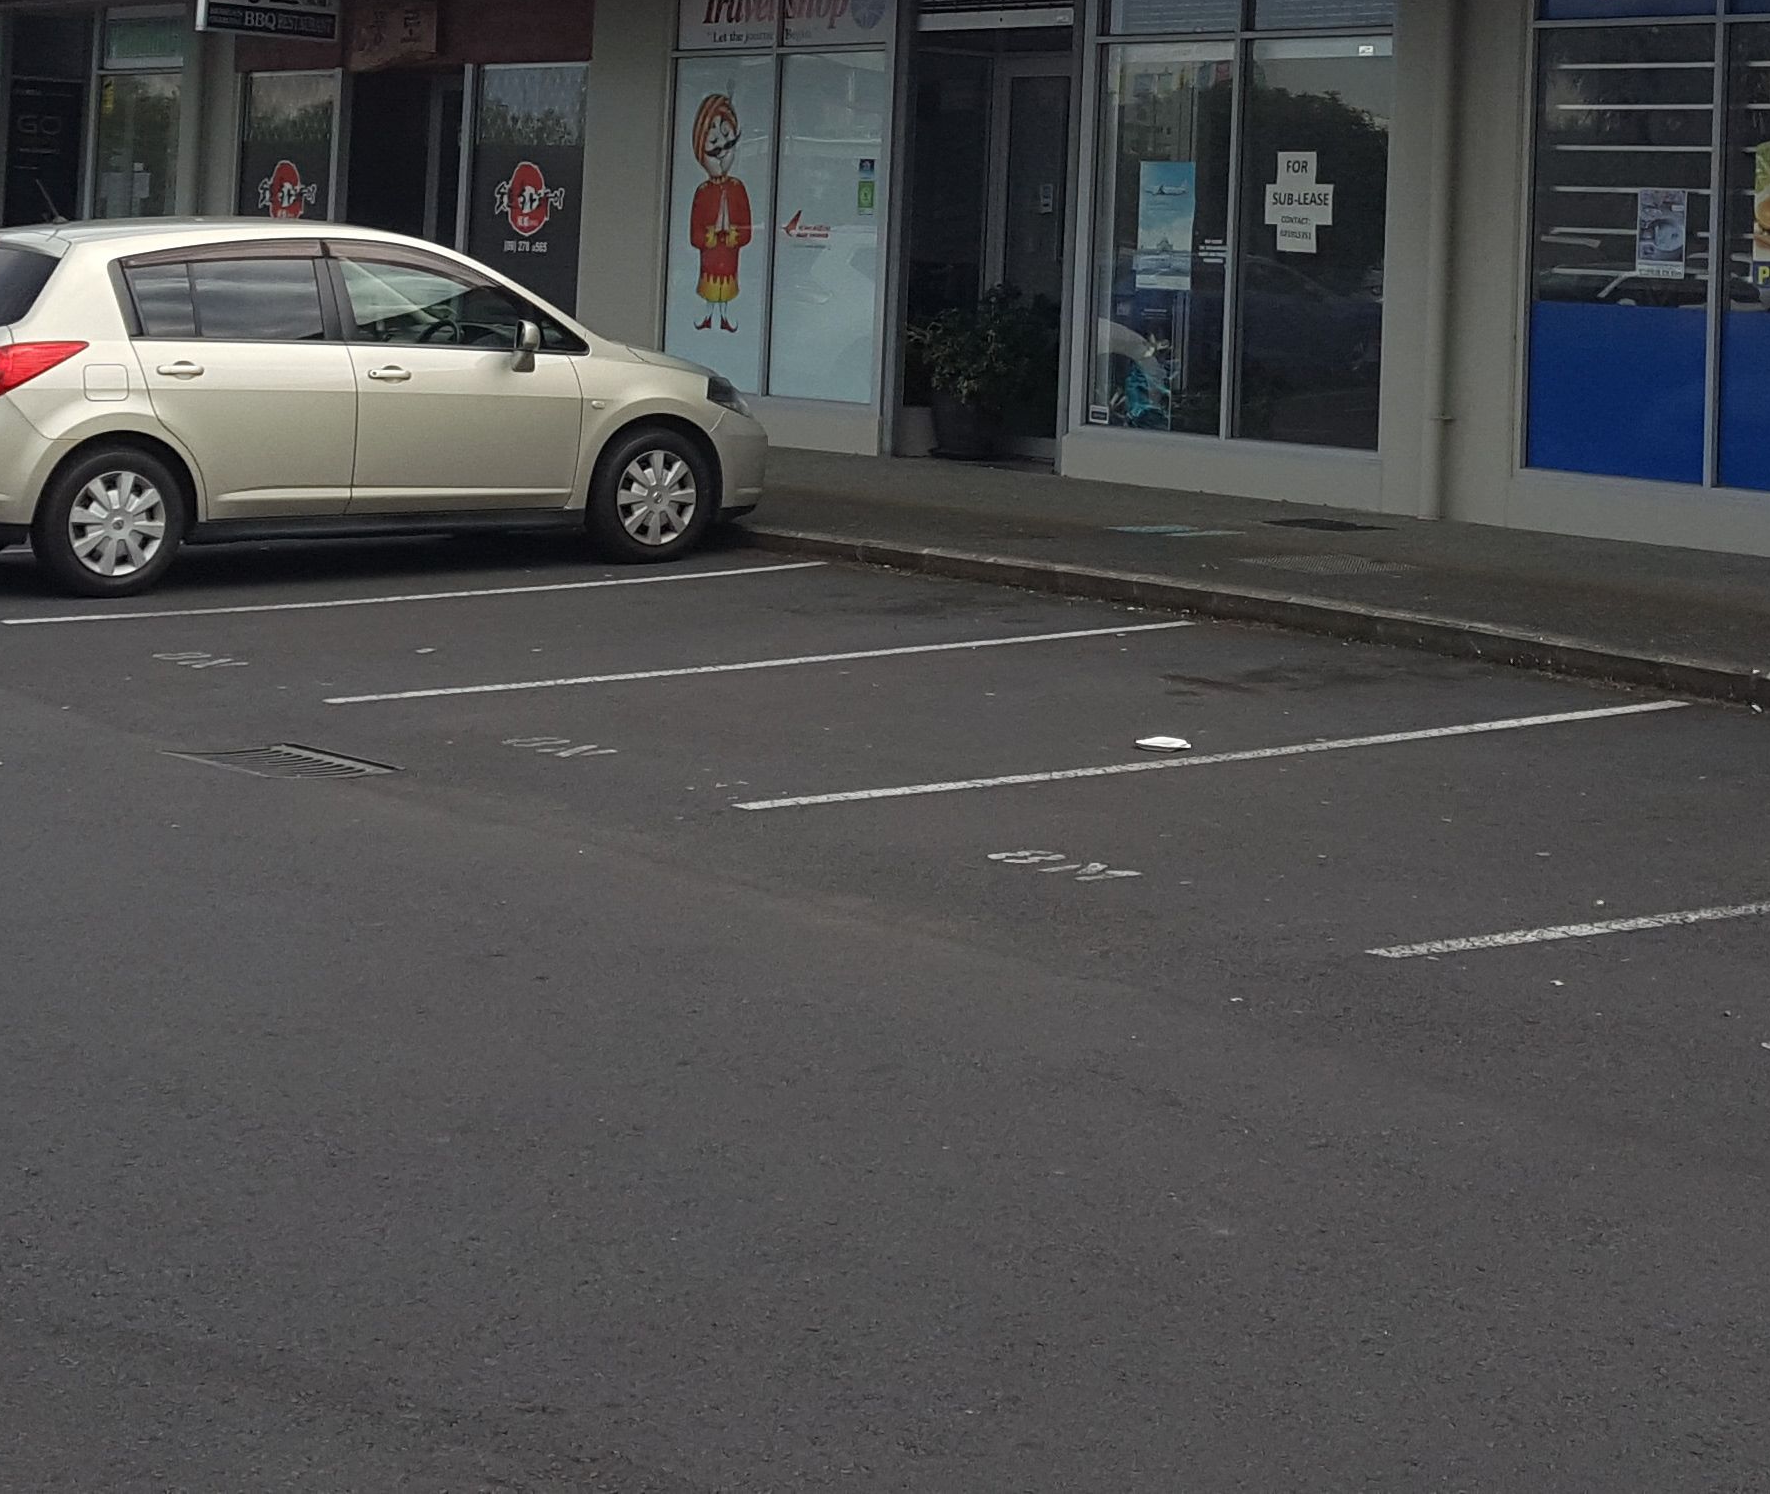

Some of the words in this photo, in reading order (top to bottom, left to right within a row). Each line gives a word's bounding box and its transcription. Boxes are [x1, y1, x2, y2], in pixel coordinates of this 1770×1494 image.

[244, 11, 277, 31] BBQ
[1286, 160, 1309, 174] FOR
[1272, 192, 1329, 206] SUB-LEASE
